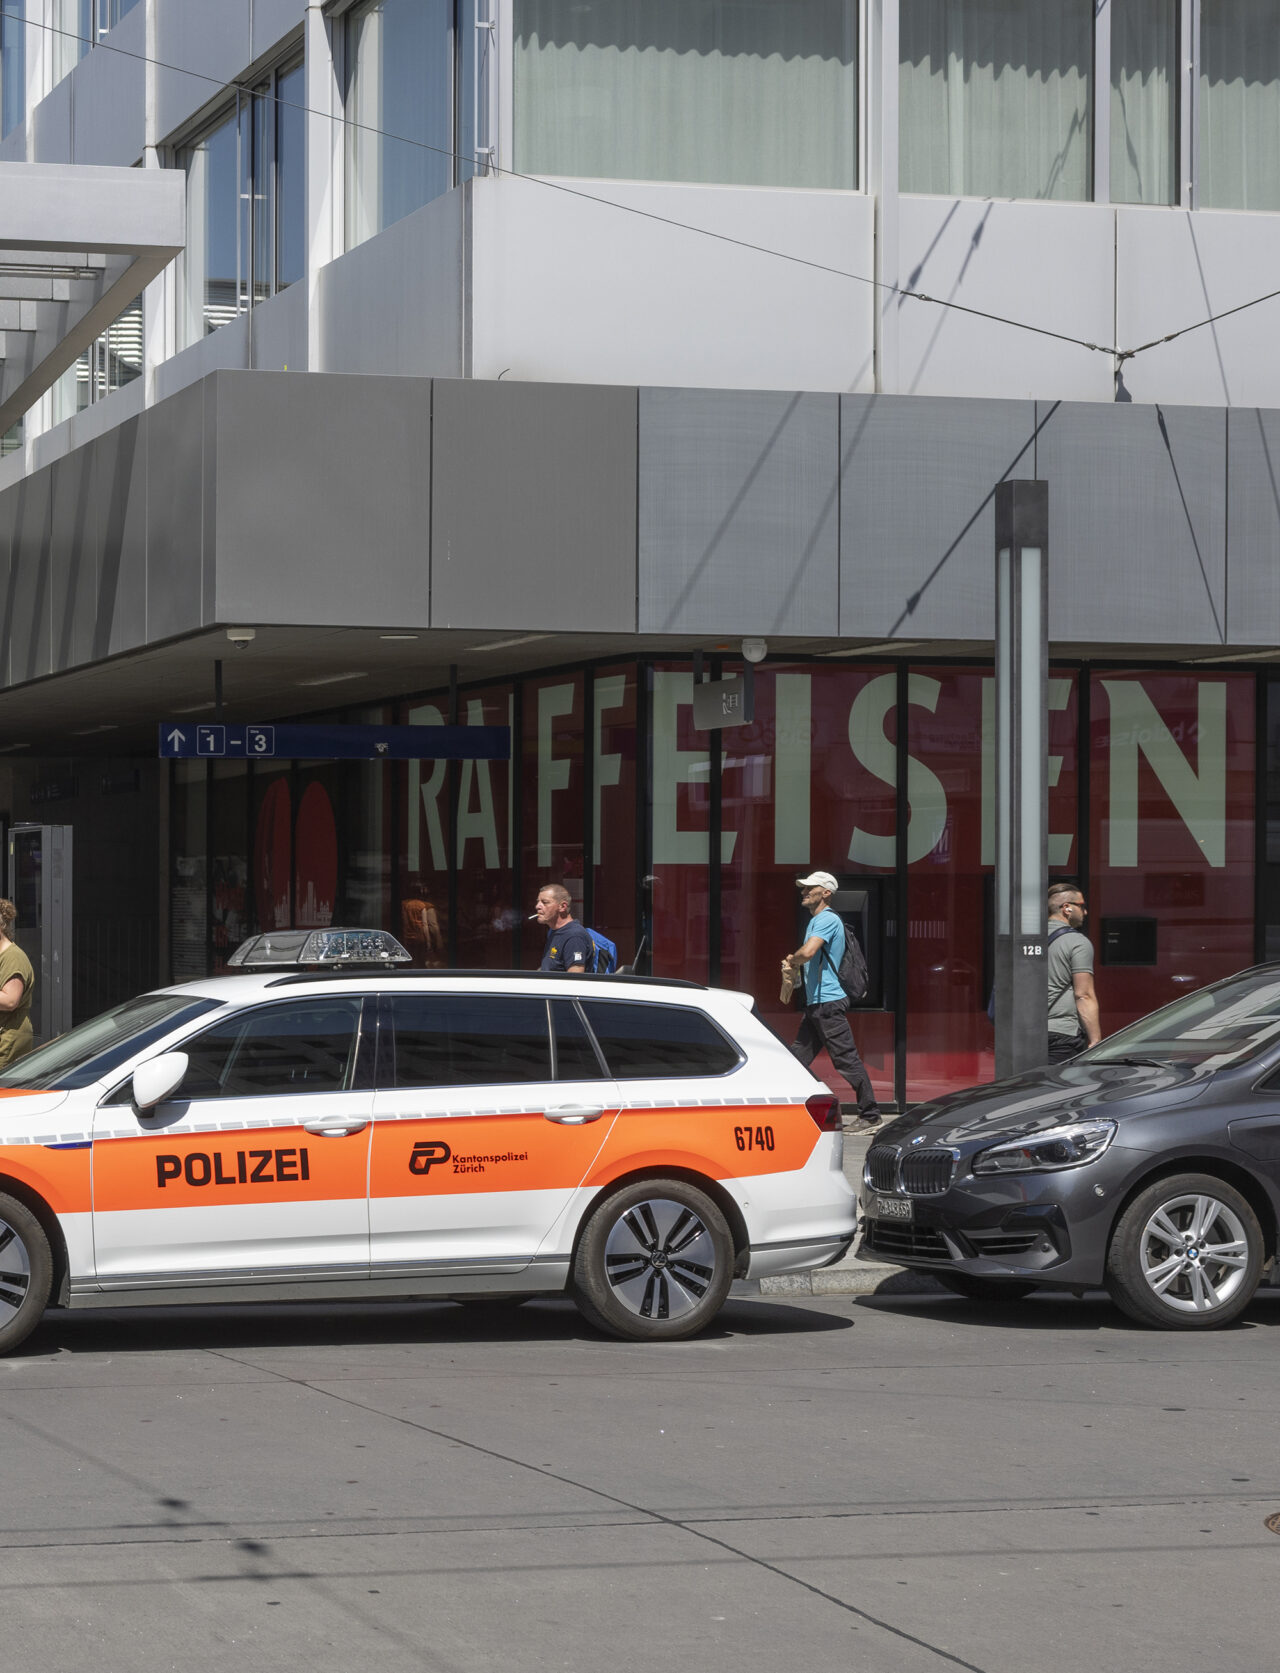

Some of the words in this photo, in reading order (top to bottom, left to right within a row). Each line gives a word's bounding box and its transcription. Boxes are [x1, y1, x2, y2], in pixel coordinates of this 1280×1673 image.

[206, 734, 215, 752] 1
[254, 734, 267, 752] 3
[1022, 945, 1042, 956] 12B
[734, 1126, 775, 1151] 6740
[452, 1152, 528, 1164] Kantonspolizei
[156, 1148, 310, 1188] POLIZEI
[453, 1163, 485, 1173] Zürich
